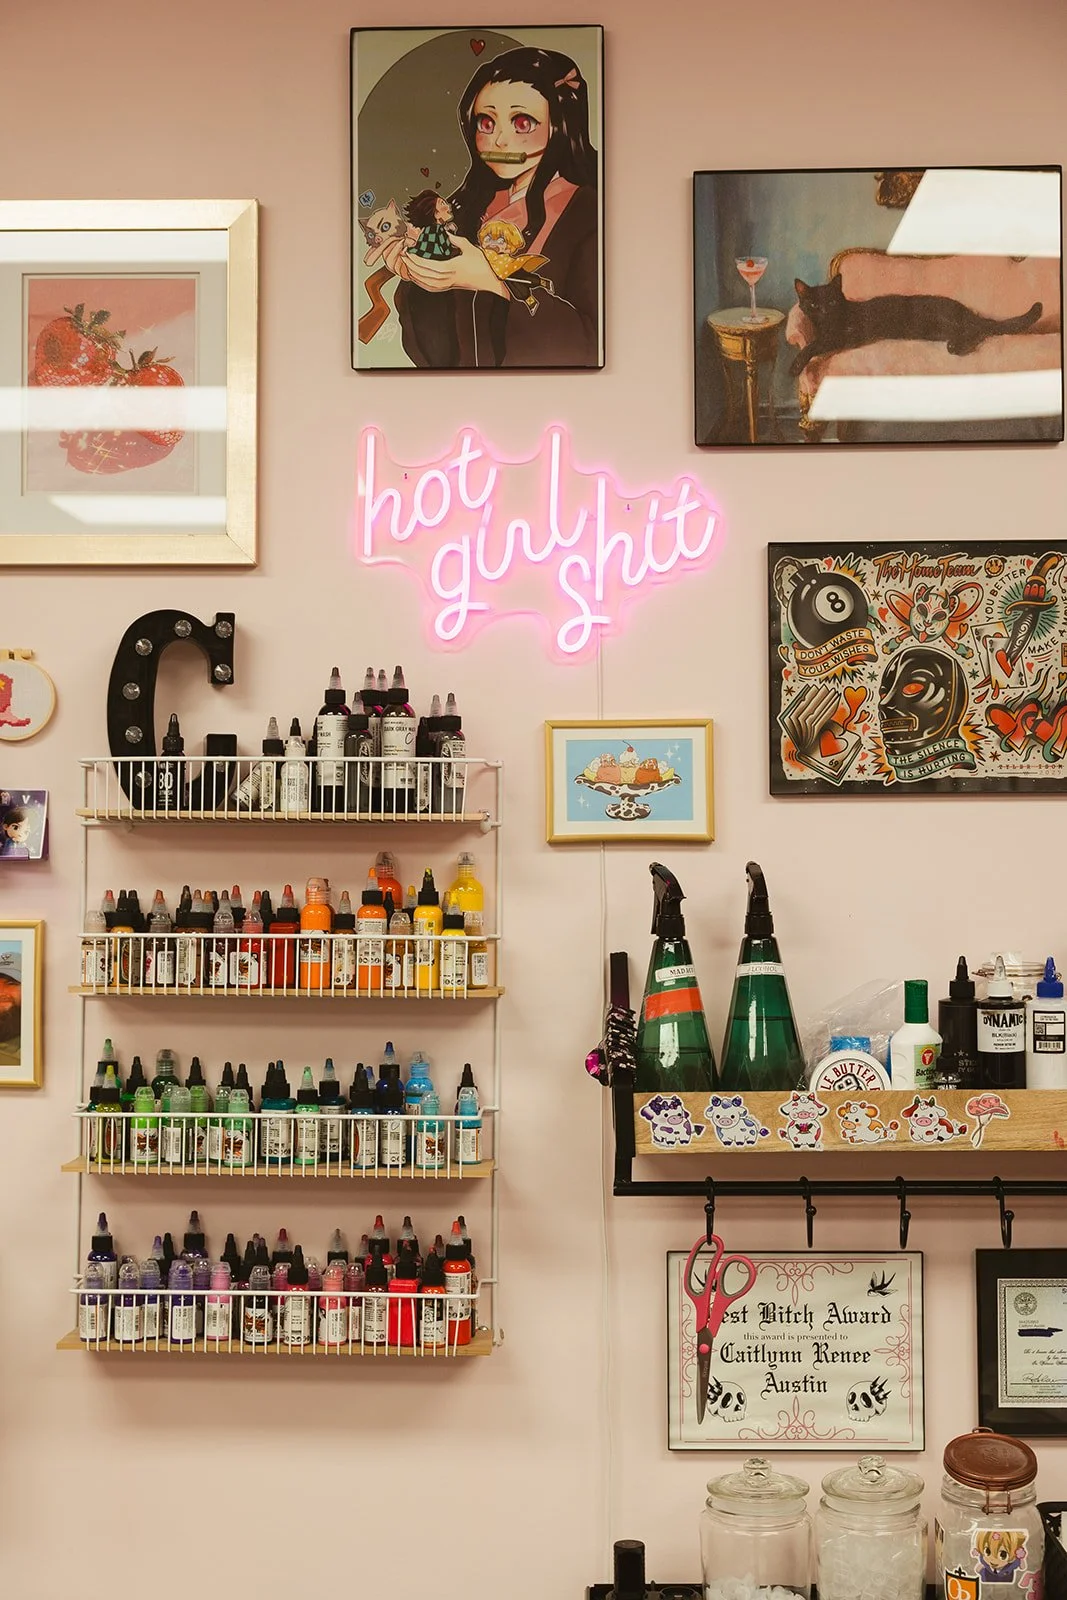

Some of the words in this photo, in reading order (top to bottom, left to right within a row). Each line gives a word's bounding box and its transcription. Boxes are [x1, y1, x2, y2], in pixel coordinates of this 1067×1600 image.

[363, 434, 497, 557] hot
[431, 433, 589, 641] girl
[873, 551, 904, 586] The
[896, 553, 939, 588] Home
[938, 553, 982, 586] Team
[989, 568, 1027, 597] BETTER
[826, 591, 846, 613] 8
[985, 599, 995, 622] YOU
[800, 645, 829, 660] DON'T
[829, 629, 865, 648] WASTE
[1027, 637, 1059, 654] MAKE
[802, 662, 831, 674] YOUR
[831, 644, 869, 664] WISHES
[893, 755, 914, 764] THE
[918, 740, 960, 759] SILENCE
[903, 769, 914, 778] IS
[919, 753, 966, 774] HURTING
[983, 1013, 1025, 1028] DYNAMIC
[832, 1062, 876, 1087] BUTTER
[719, 1303, 749, 1324] est
[757, 1302, 814, 1331] Bitch
[822, 1302, 891, 1332] Award
[743, 1332, 761, 1341] this
[762, 1333, 785, 1341] award
[788, 1333, 795, 1341] is
[797, 1333, 837, 1342] presented
[839, 1333, 848, 1341] to
[720, 1342, 802, 1370] Caitlynn
[812, 1342, 871, 1370] Renee
[760, 1372, 828, 1400] Austin
